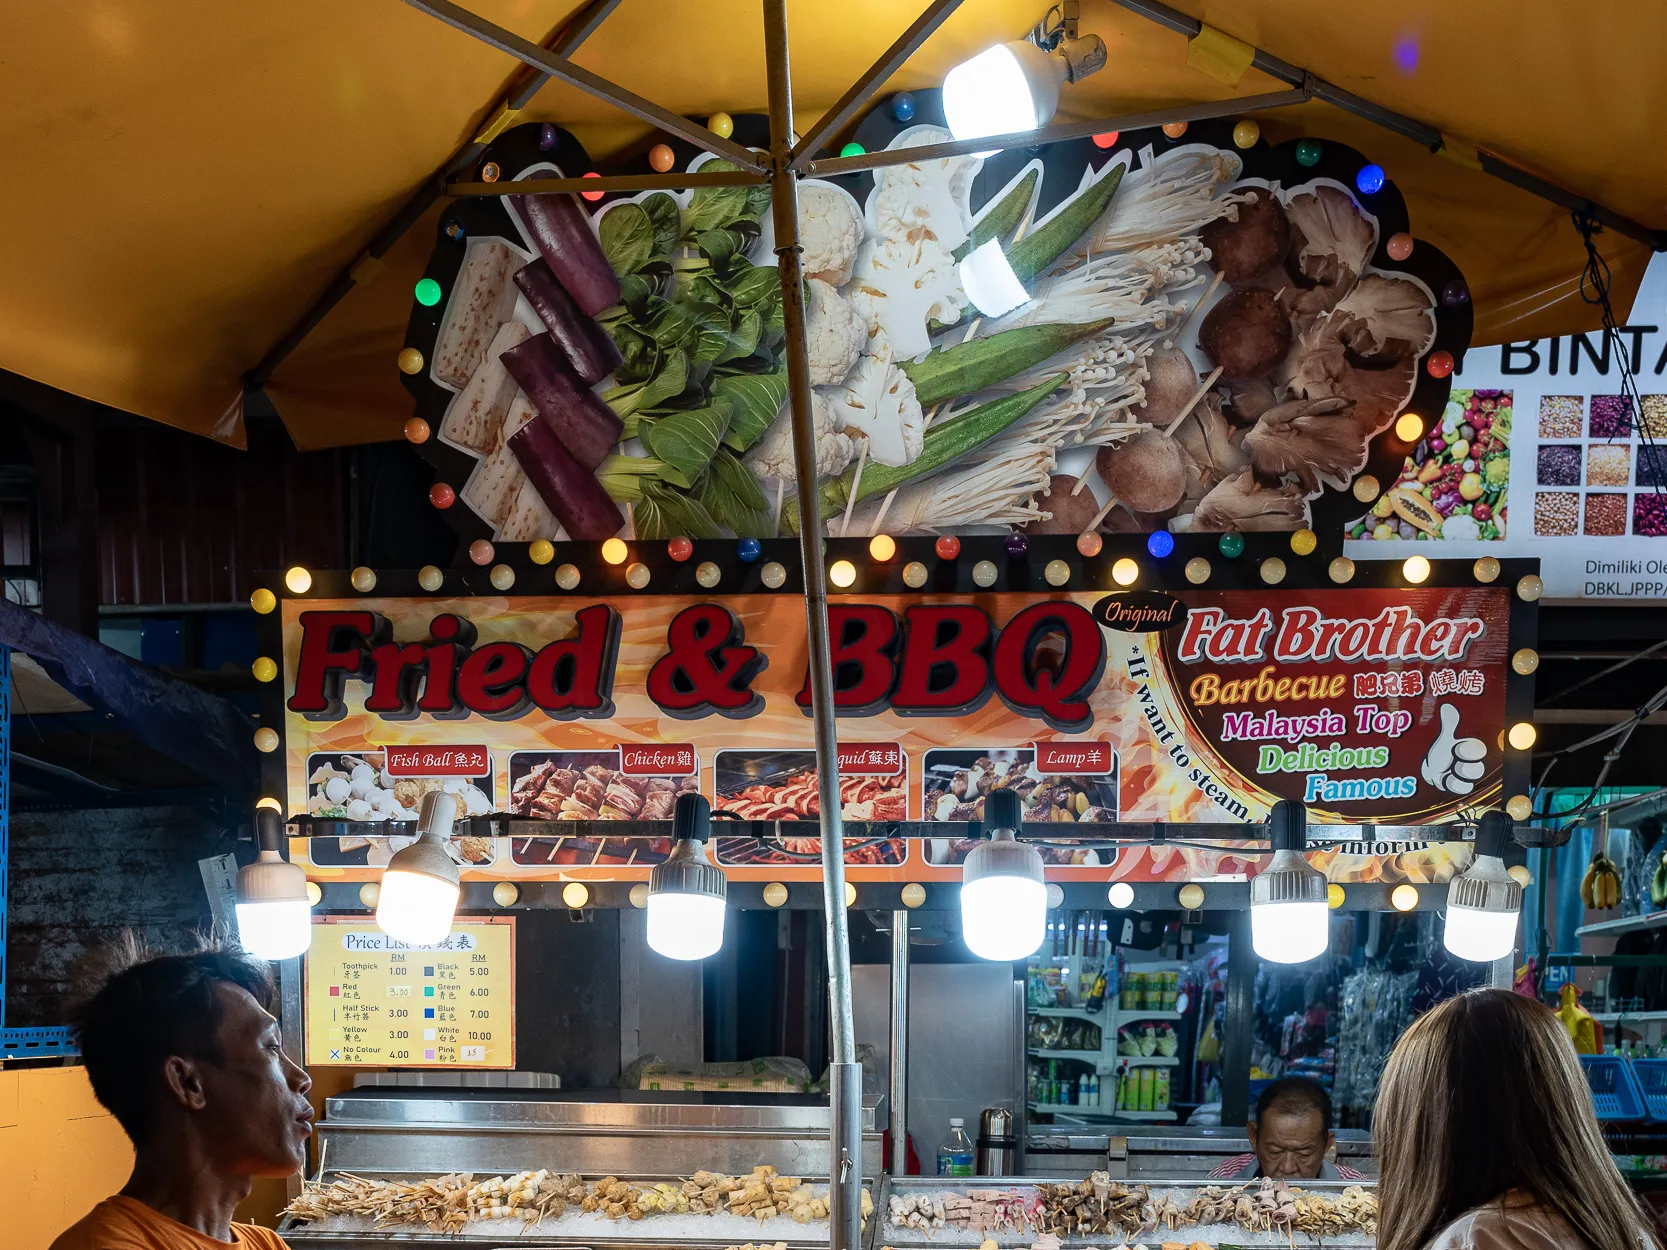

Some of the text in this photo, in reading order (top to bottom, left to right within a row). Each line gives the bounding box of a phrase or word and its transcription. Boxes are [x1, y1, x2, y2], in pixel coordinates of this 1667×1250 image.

[1585, 560, 1642, 574] Dimiliki
[1105, 601, 1175, 631] Original
[1178, 606, 1485, 661] Fat Brother
[288, 601, 1104, 728] Fried & BBQ
[1190, 666, 1347, 706] Barbecue
[1354, 668, 1486, 698] 肥兄弟 燒烤
[1136, 682, 1176, 744] want
[1169, 743, 1190, 768] to
[1221, 704, 1412, 743] Malaysia Top
[391, 752, 485, 768] Fish Ball 魚丸
[624, 751, 676, 768] Chicken
[838, 751, 867, 768] quid
[1046, 750, 1103, 768] Lamp 羊
[1256, 742, 1390, 773] Delicious
[1304, 774, 1417, 803] Famous
[346, 935, 381, 949] Price
[391, 953, 405, 961] RM
[343, 962, 407, 976] Toothpick 1.00
[469, 967, 489, 976] 5.00
[389, 987, 409, 996] 3.00
[469, 988, 489, 997] 6.00
[389, 1009, 408, 1018] 3.00
[470, 1010, 489, 1019] 7.00
[389, 1030, 409, 1039] 3.00
[468, 1031, 492, 1040] 10.00
[389, 1050, 409, 1059] 4.00
